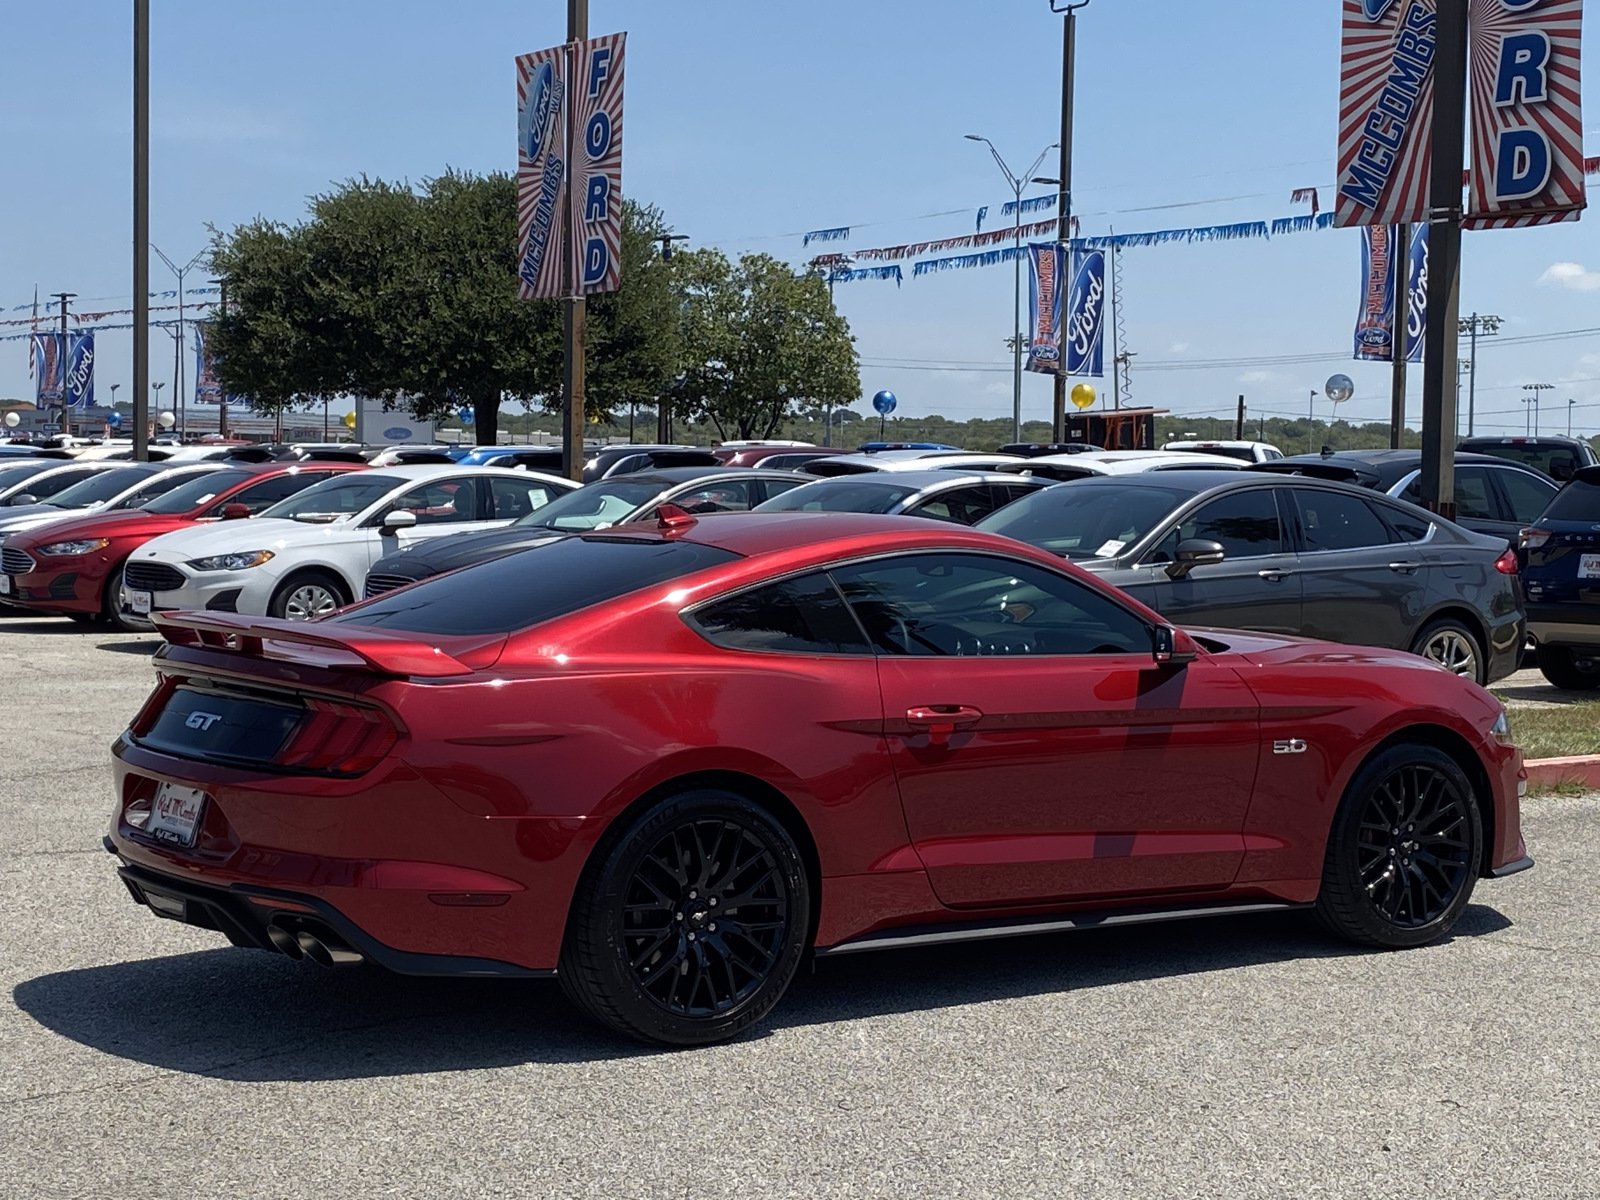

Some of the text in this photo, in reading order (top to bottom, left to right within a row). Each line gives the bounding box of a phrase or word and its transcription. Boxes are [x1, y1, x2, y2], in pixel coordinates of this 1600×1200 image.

[530, 79, 550, 144] Ford
[583, 47, 611, 285] FORD
[1068, 269, 1103, 356] Ford
[1364, 329, 1385, 344] Ford
[67, 345, 93, 396] Ford
[1036, 346, 1055, 359] Ford
[185, 711, 222, 731] GT
